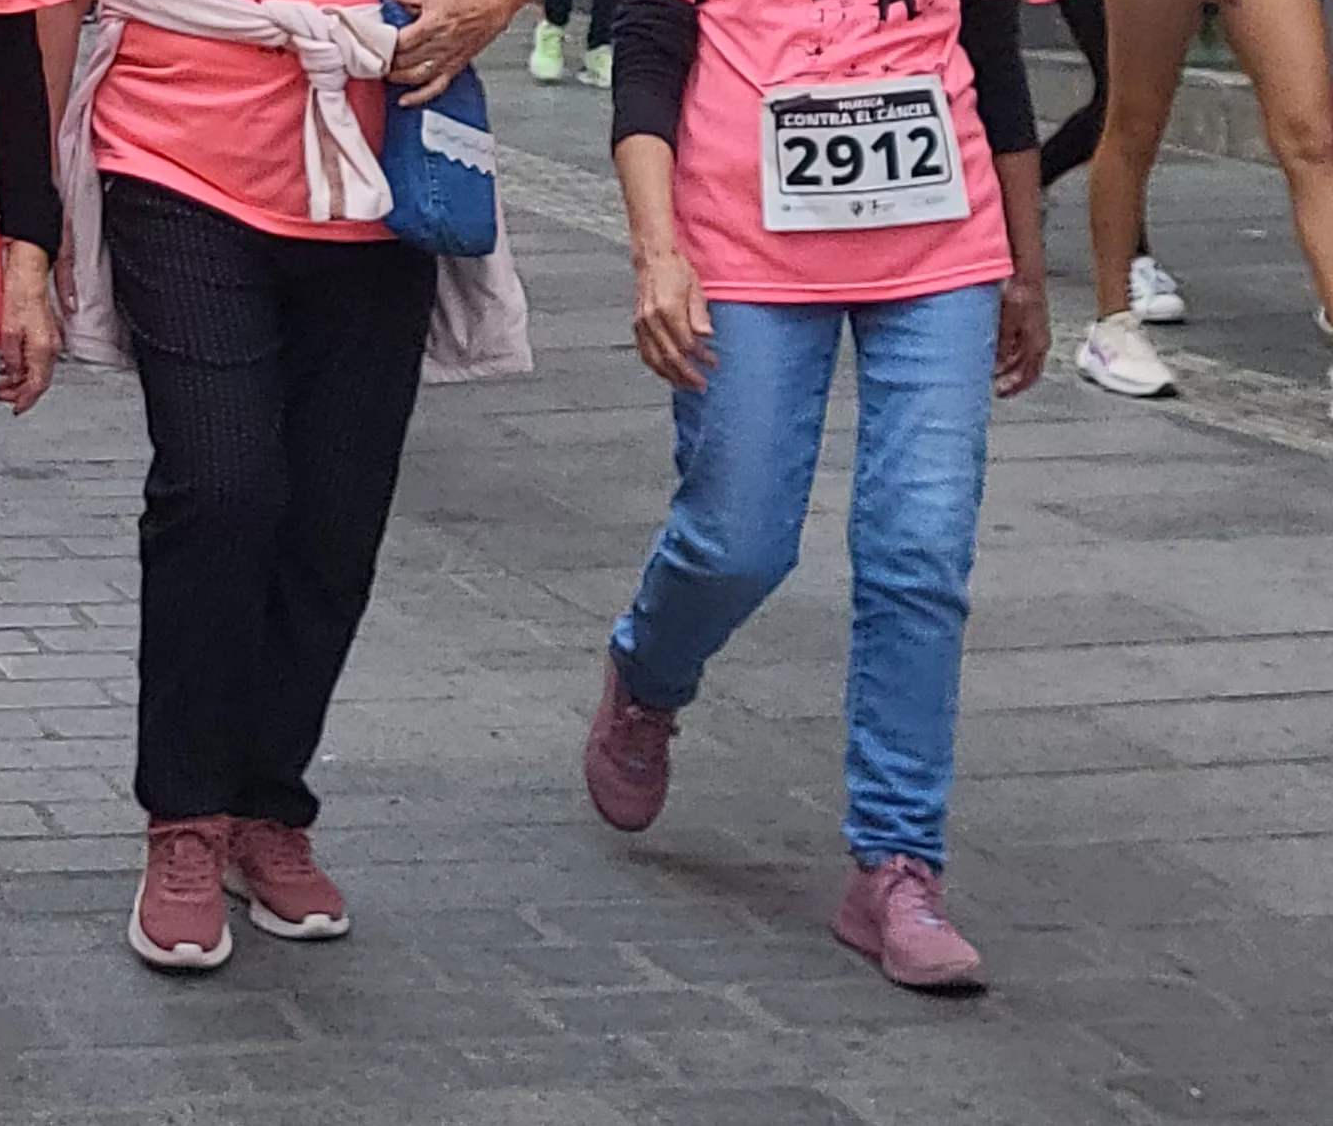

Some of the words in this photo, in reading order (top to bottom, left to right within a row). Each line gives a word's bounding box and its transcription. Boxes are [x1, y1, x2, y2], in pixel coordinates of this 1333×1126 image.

[784, 111, 853, 127] CONTRA
[856, 109, 872, 123] EL
[877, 101, 932, 121] CÁNCER
[783, 126, 944, 187] 2912
